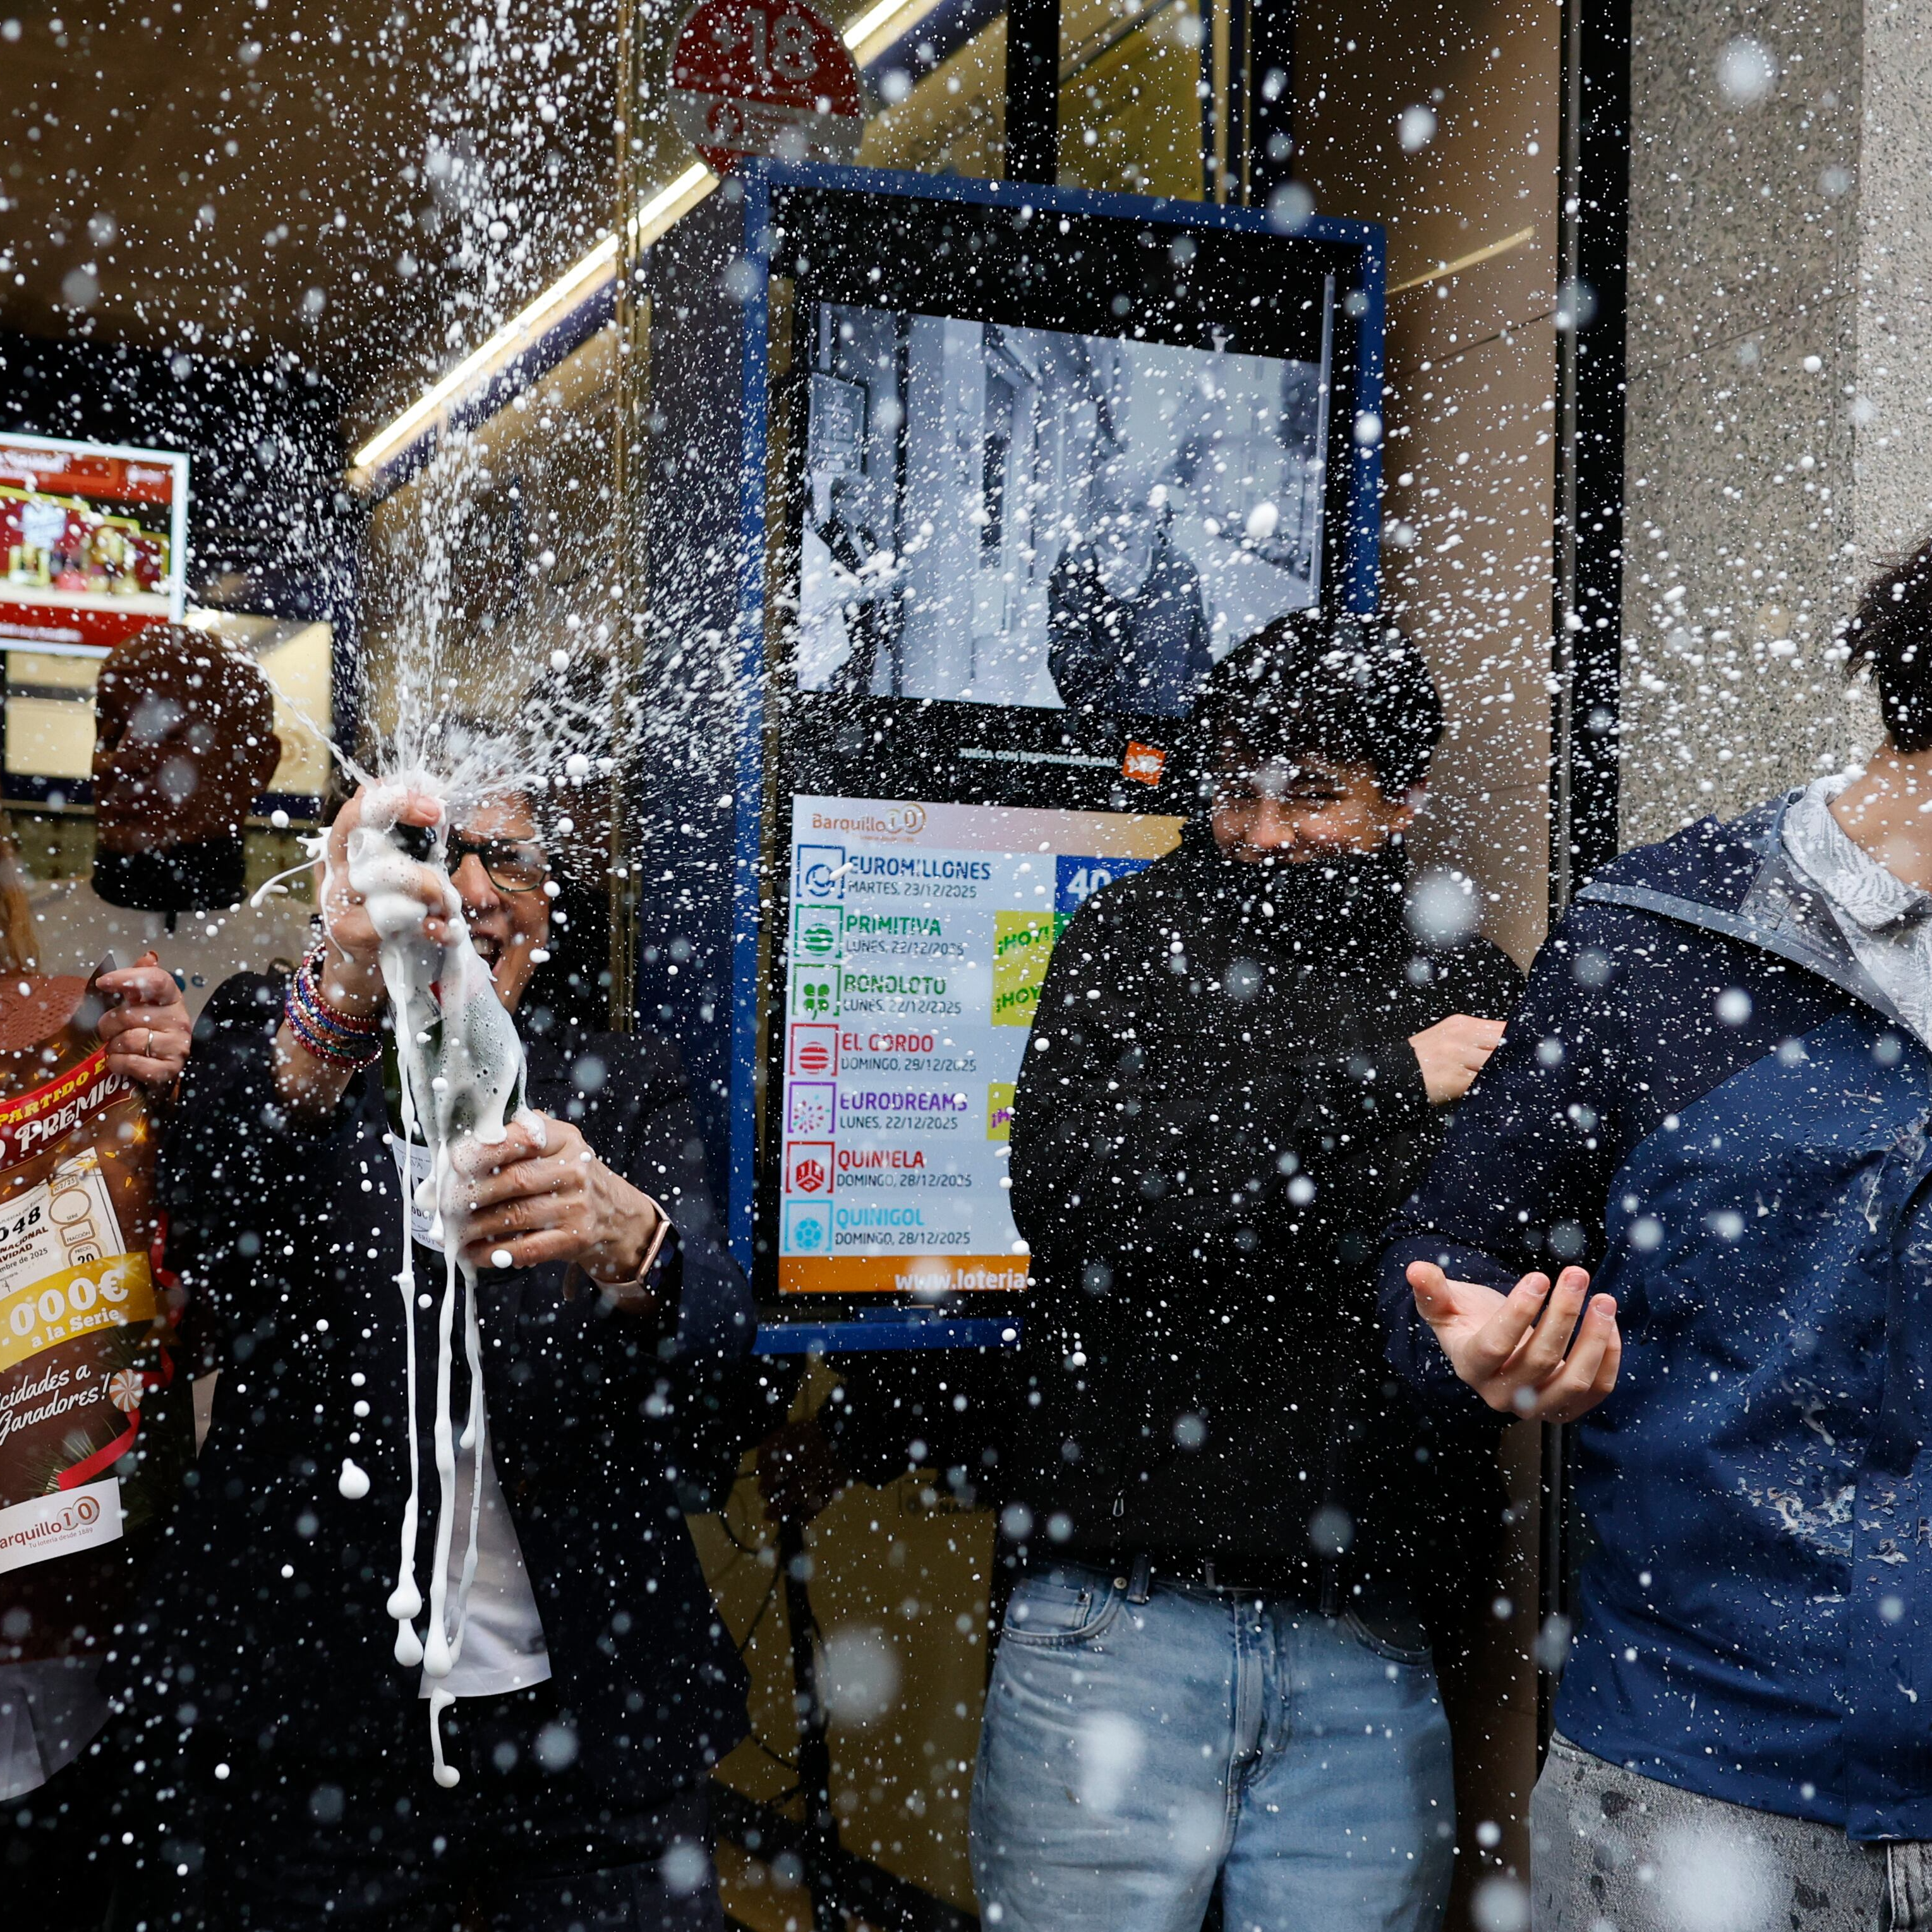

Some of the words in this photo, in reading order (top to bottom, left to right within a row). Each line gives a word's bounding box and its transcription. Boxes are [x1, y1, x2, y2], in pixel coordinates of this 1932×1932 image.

[711, 8, 819, 80] +18
[848, 856, 991, 880] EUROMILLONES
[904, 883, 977, 898] 23/12/2025
[847, 915, 941, 936] PRIMITIVA
[892, 941, 965, 956] 22/12/2025
[998, 926, 1049, 955] ¡HOY!
[845, 974, 946, 994] BONOLOTO
[889, 999, 962, 1014] 22/12/2025
[996, 985, 1042, 1013] ¡HOY
[842, 1033, 862, 1051] EL
[869, 1034, 934, 1053] GORDO
[841, 1057, 901, 1071] DOMINGO,
[905, 1058, 977, 1072] 28/12/2025
[0, 1071, 90, 1127] PARTIDO
[840, 1092, 968, 1112] EURODREAMS
[840, 1116, 883, 1130] LUNES,
[886, 1116, 958, 1130] 22/12/2025
[838, 1150, 925, 1171] QUINIELA
[837, 1173, 896, 1188] DOMINGO,
[900, 1174, 972, 1188] 28/12/2025
[0, 1205, 41, 1243] 048
[836, 1208, 925, 1229] QUINIGOL
[0, 1226, 49, 1253] NACIONAL
[67, 1231, 90, 1243] FRACCIÓN
[835, 1231, 895, 1246] DOMINGO,
[898, 1232, 971, 1245] 28/12/2025
[75, 1245, 92, 1254] PRECIO
[0, 1261, 17, 1273] mbre
[19, 1256, 28, 1264] de
[30, 1248, 48, 1260] 2025
[895, 1268, 1029, 1289] www.loteria
[2, 1269, 129, 1346] .000€
[32, 1336, 44, 1348] a
[45, 1325, 66, 1342] la
[69, 1307, 121, 1332] Serie
[0, 1365, 70, 1411] cidades
[75, 1364, 91, 1380] a
[0, 1372, 111, 1446] Ganadores!
[59, 1531, 77, 1541] desde
[78, 1527, 94, 1537] 1889
